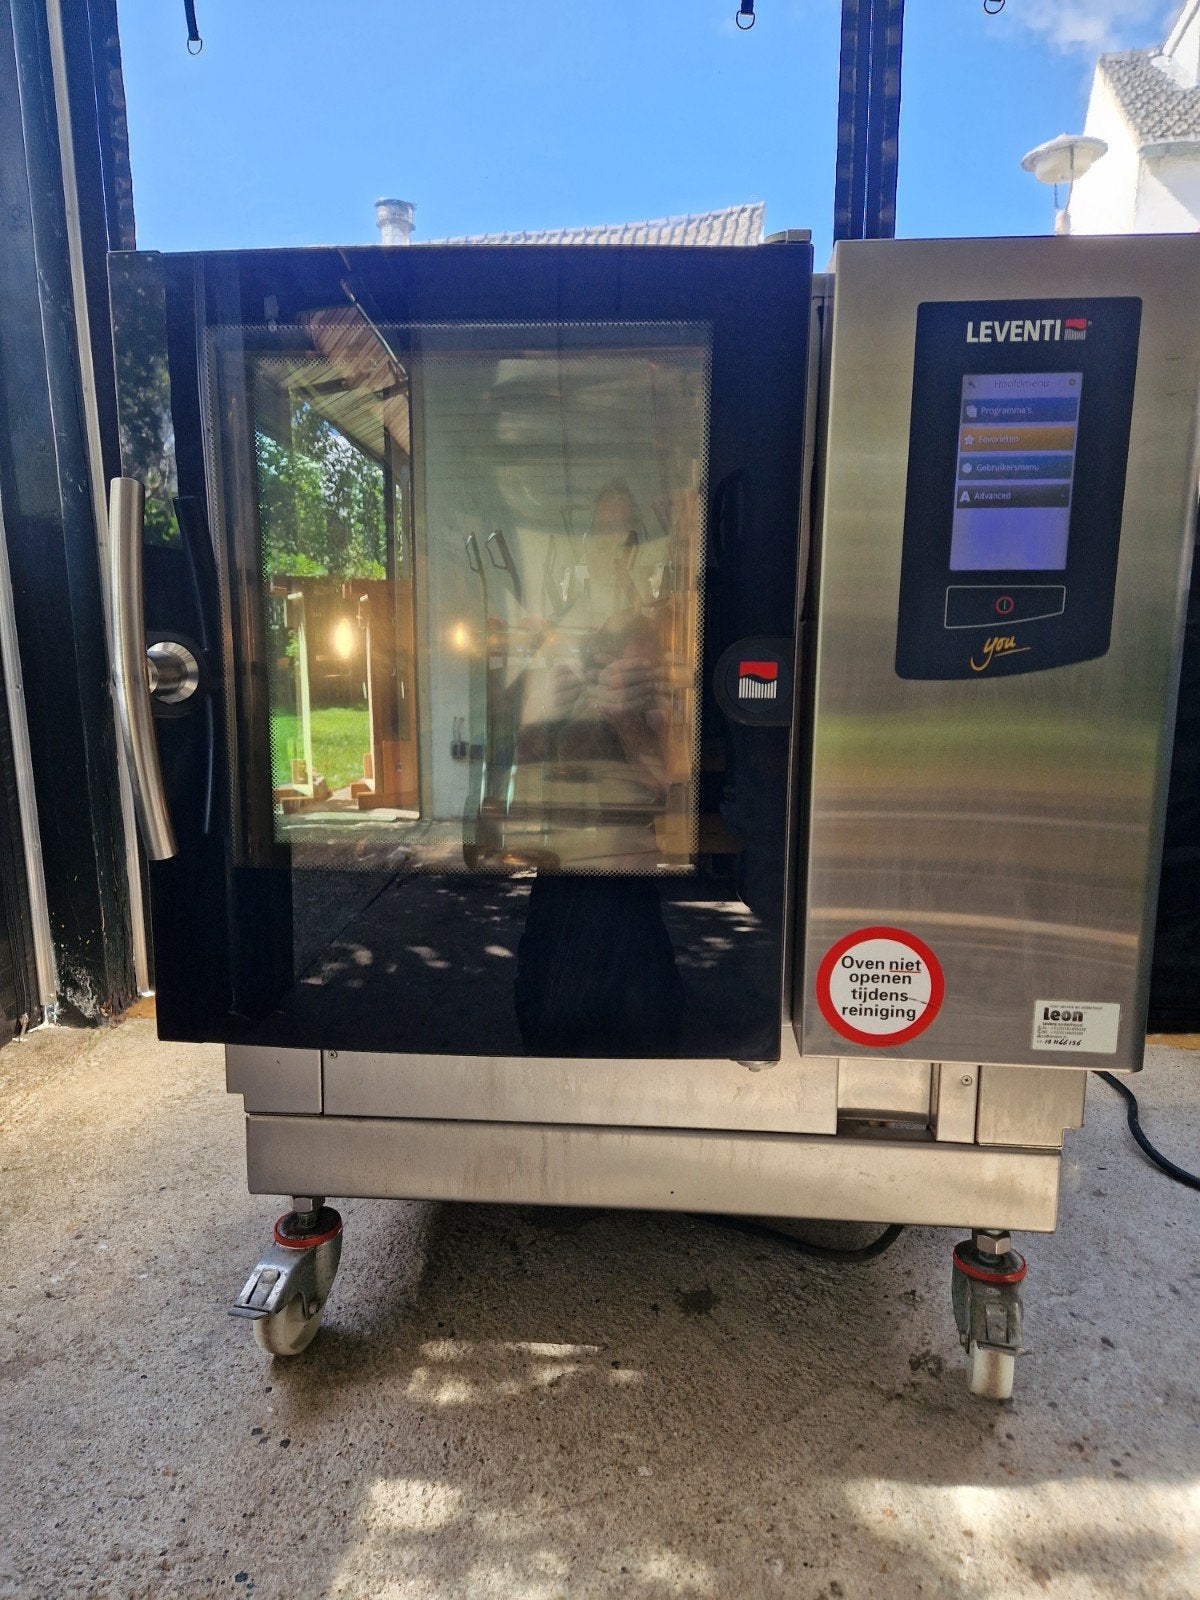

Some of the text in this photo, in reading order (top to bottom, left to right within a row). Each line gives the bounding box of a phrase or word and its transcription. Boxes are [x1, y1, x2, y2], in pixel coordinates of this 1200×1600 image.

[966, 319, 1061, 343] LEVENTI
[994, 378, 1050, 389] Hoofdmenu
[981, 406, 1032, 416] Programma's
[978, 435, 1019, 443] Favorieten
[976, 463, 1040, 472] Gebruikersmenu
[974, 492, 1011, 500] Advanced
[969, 636, 1031, 671] you
[841, 955, 922, 972] Oven niet
[849, 972, 912, 986] openen
[851, 987, 909, 1003] tijdens
[842, 1004, 916, 1021] reiniging
[1043, 1007, 1084, 1022] leon
